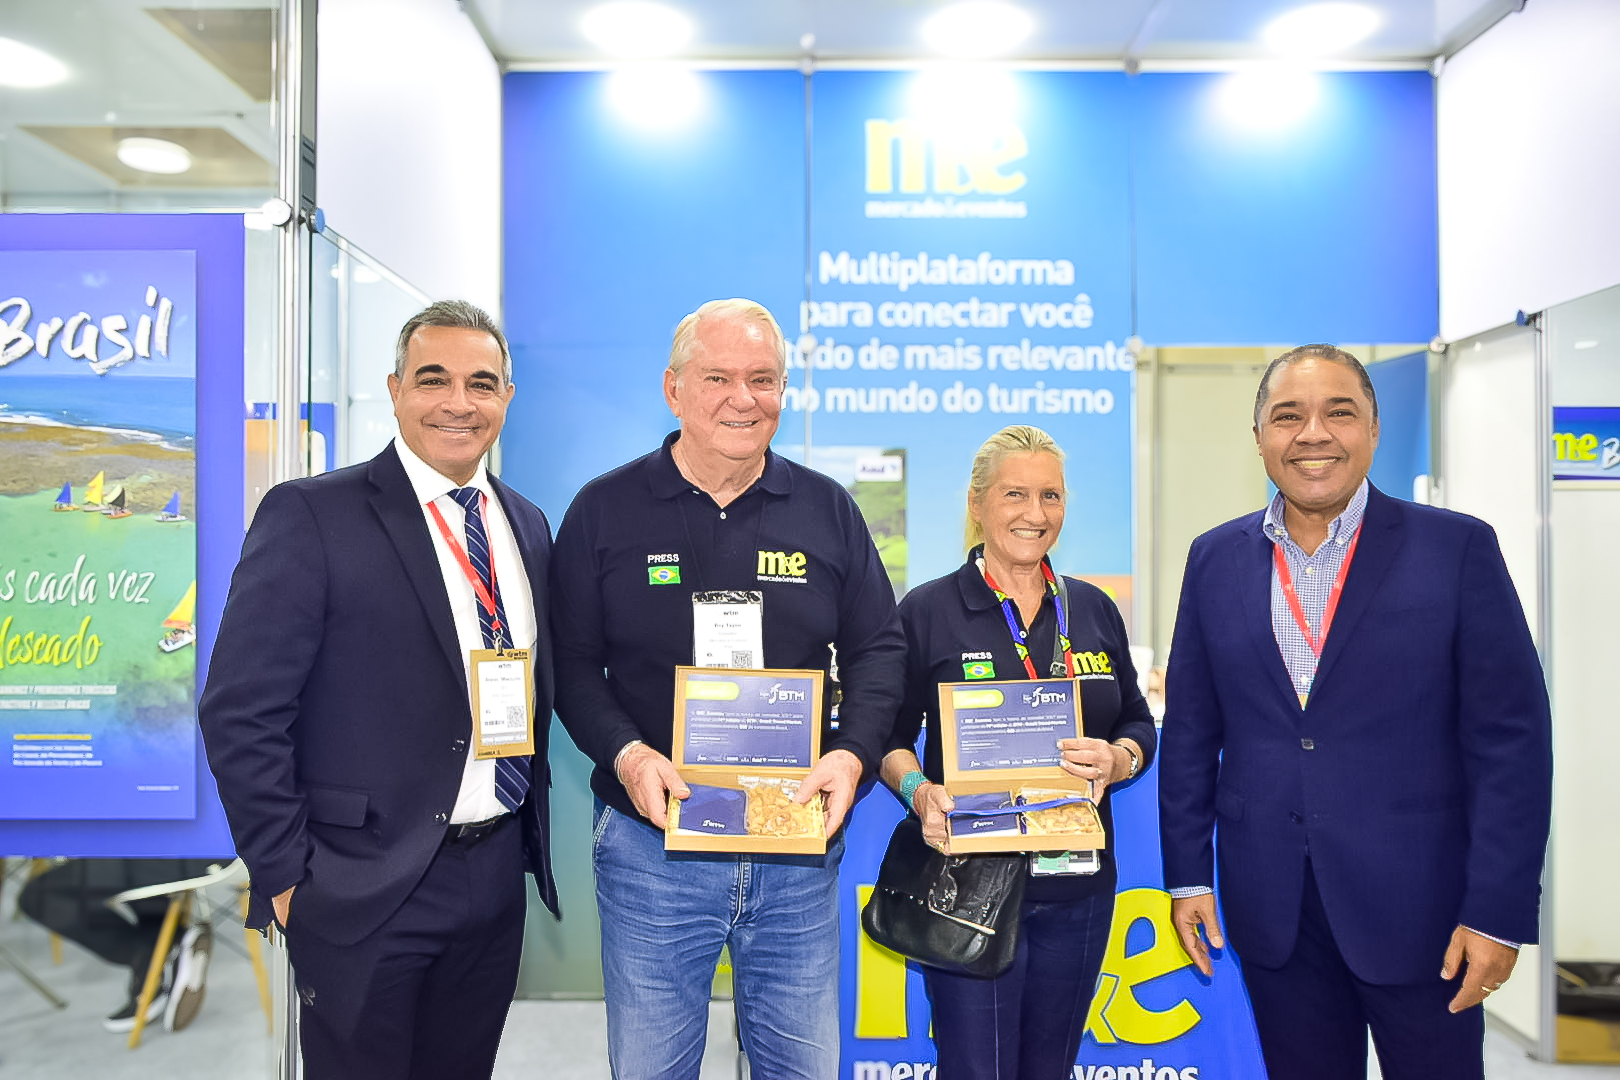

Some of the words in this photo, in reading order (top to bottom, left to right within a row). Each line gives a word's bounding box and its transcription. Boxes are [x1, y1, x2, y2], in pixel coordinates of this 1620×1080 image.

[819, 251, 1075, 292] Multiplataforma
[0, 285, 173, 375] Brasil
[800, 300, 874, 334] para
[878, 296, 1017, 328] conectar
[1019, 292, 1095, 329] você
[857, 338, 900, 371] de
[904, 337, 983, 371] mais
[987, 337, 1136, 372] relevante
[782, 386, 821, 413] no
[825, 380, 938, 413] mundo
[942, 380, 984, 414] do
[987, 380, 1115, 415] turismo
[647, 554, 680, 564] PRESS
[757, 550, 807, 577] m&e
[25, 554, 97, 606] cada
[108, 569, 156, 604] vez
[961, 651, 993, 661] PRESS
[778, 690, 805, 701] BTM
[1041, 692, 1066, 703] BTM
